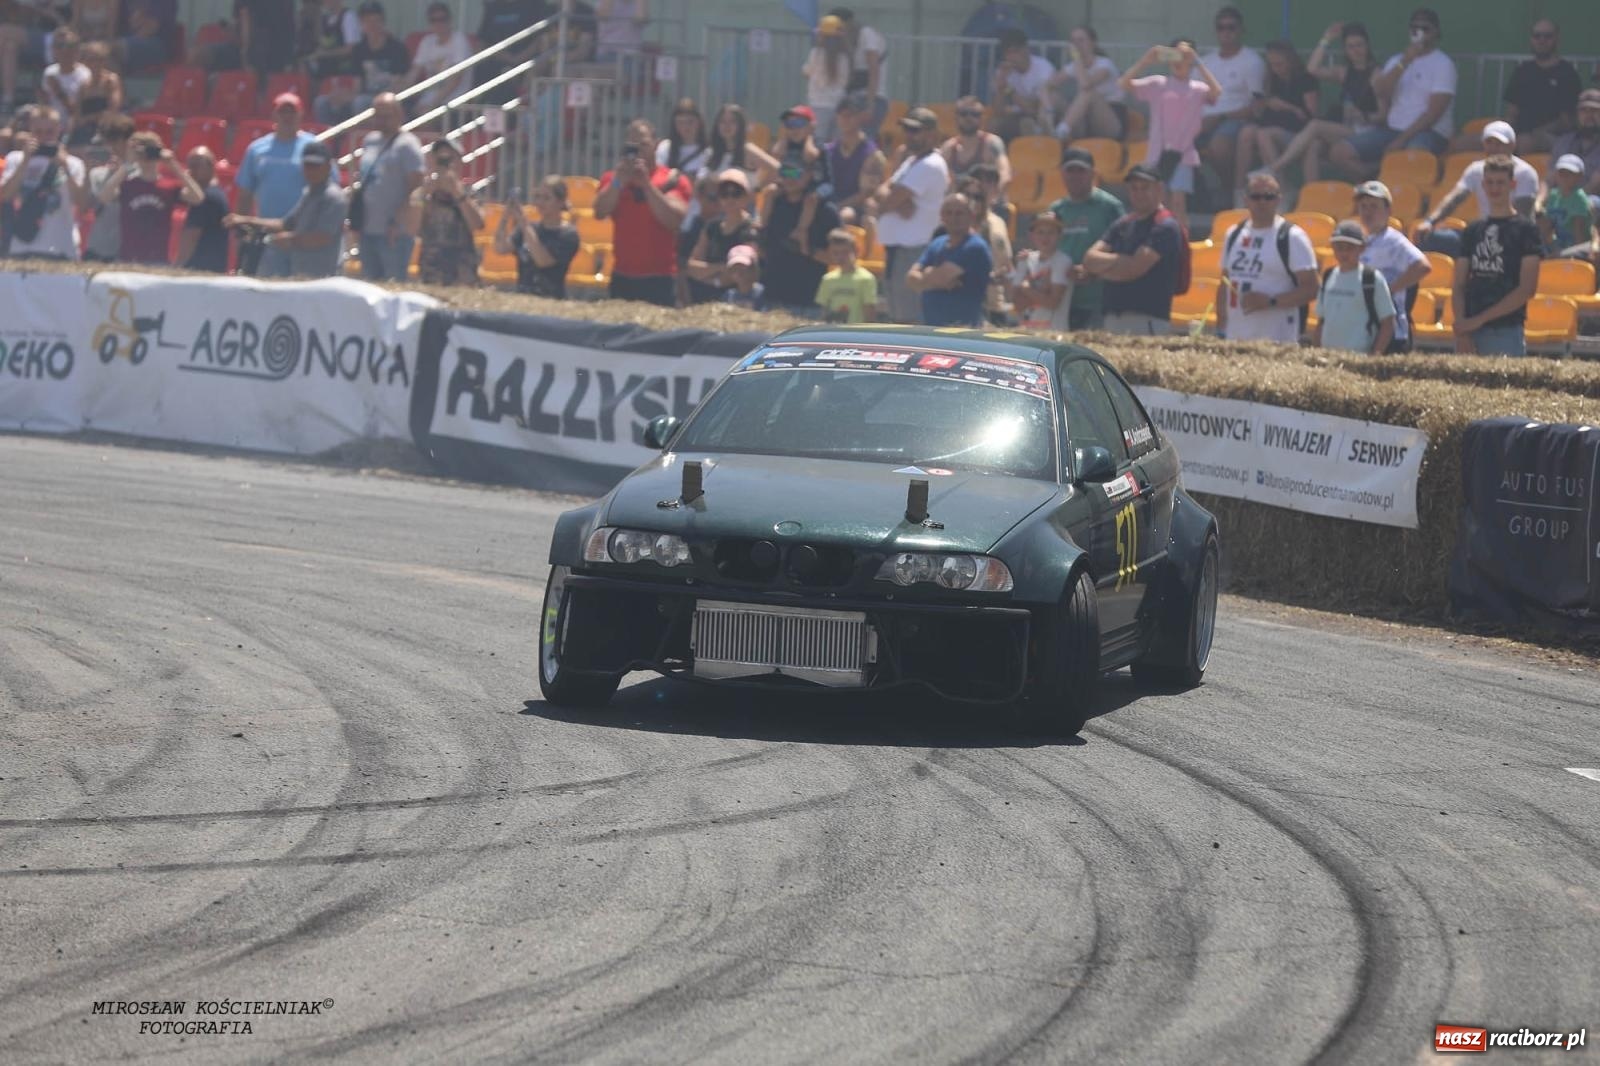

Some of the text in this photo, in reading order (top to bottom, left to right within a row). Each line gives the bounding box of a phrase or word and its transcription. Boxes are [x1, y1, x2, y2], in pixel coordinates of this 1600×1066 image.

[190, 314, 409, 387] AGRONOVA
[1263, 423, 1333, 457] WYNAJEM
[1348, 439, 1407, 468] SERWIS
[1500, 471, 1585, 498] AUTO FUS
[1509, 515, 1569, 540] GROUP
